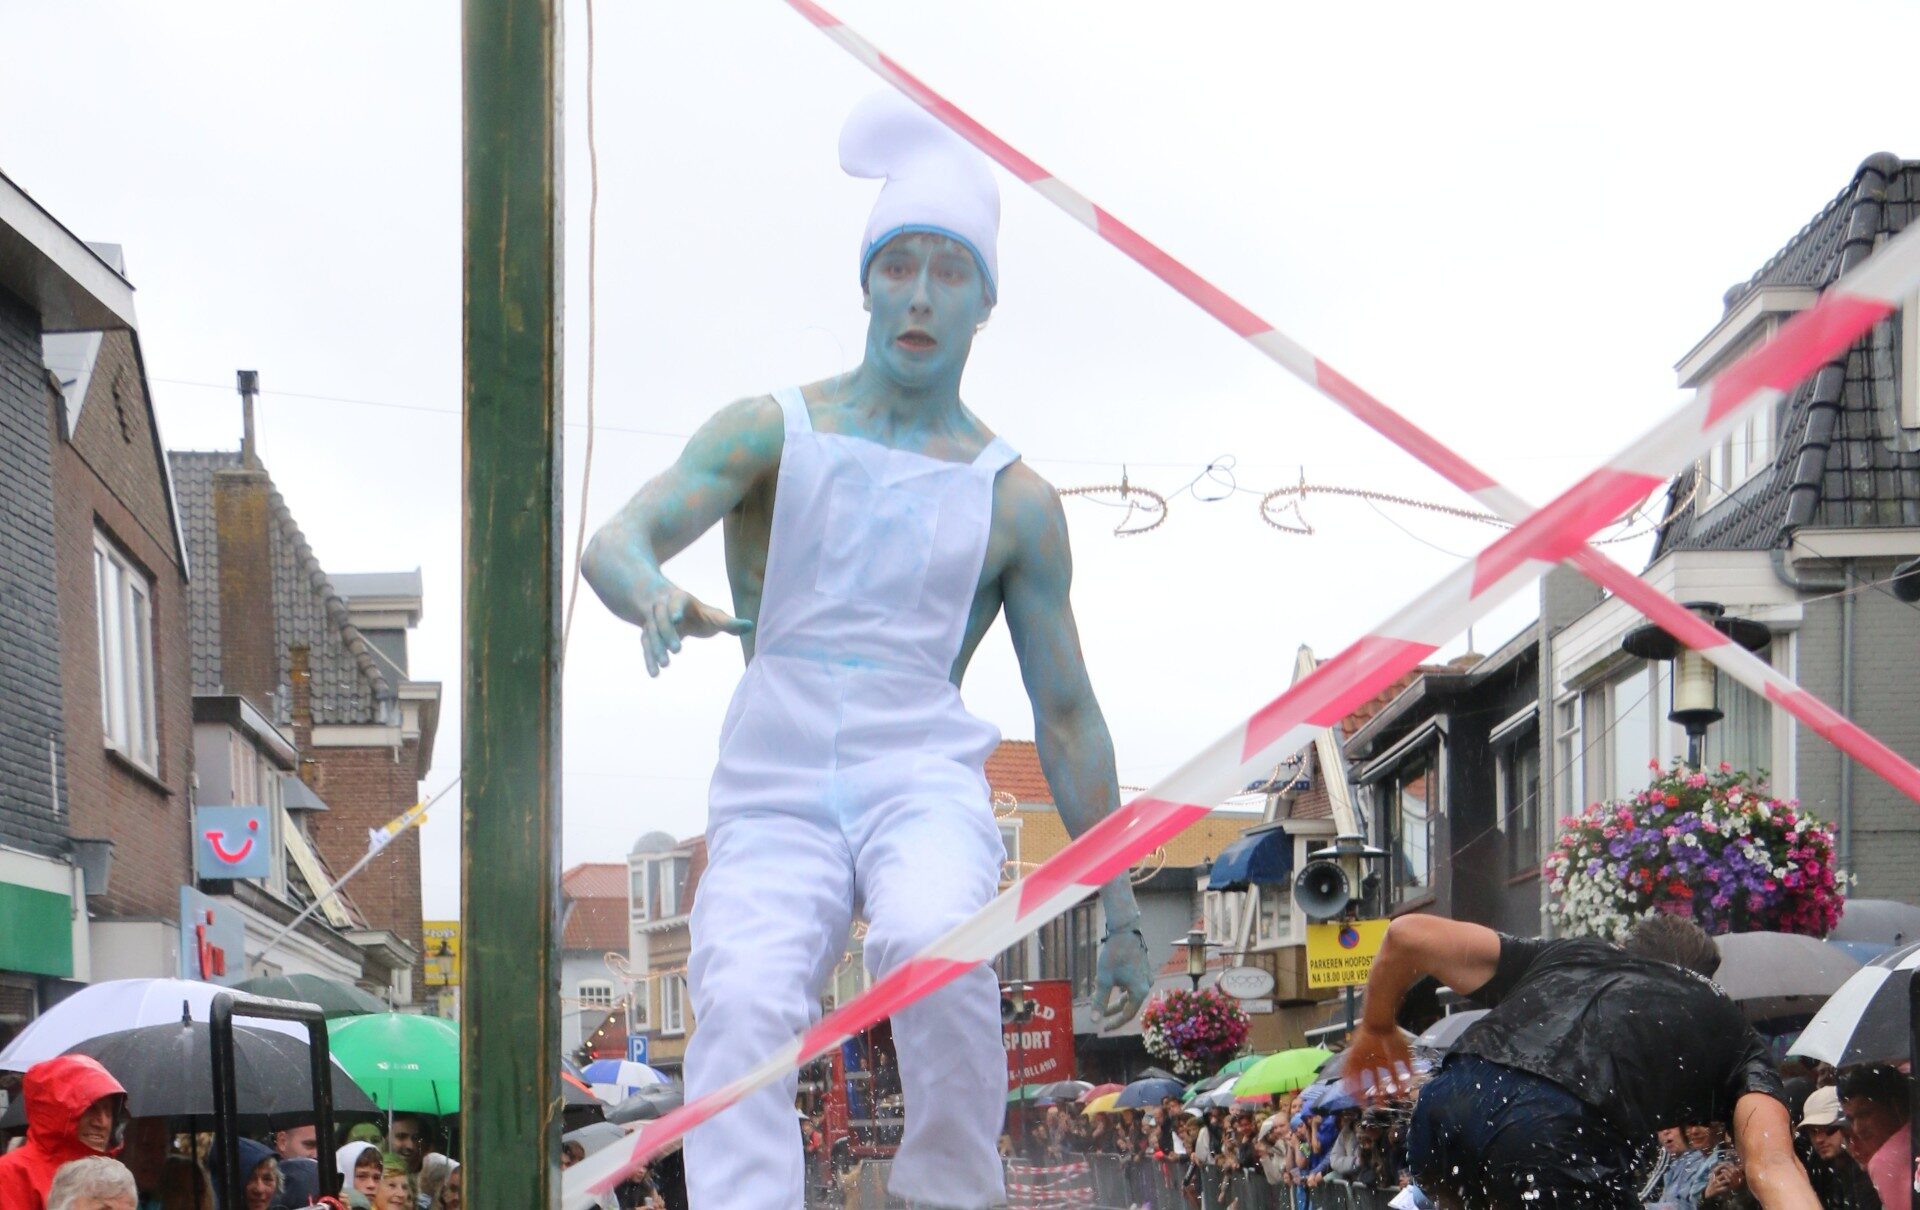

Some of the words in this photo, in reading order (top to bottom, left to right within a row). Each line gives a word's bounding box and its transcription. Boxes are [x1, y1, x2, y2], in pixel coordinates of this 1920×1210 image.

[1310, 958, 1343, 969] PARKEREN
[1344, 955, 1375, 967] HOOFDST
[1312, 973, 1321, 983] NA
[1323, 971, 1341, 982] 18.00
[1341, 970, 1355, 980] UUR
[1003, 1031, 1052, 1051] SPORT
[633, 1039, 644, 1062] P
